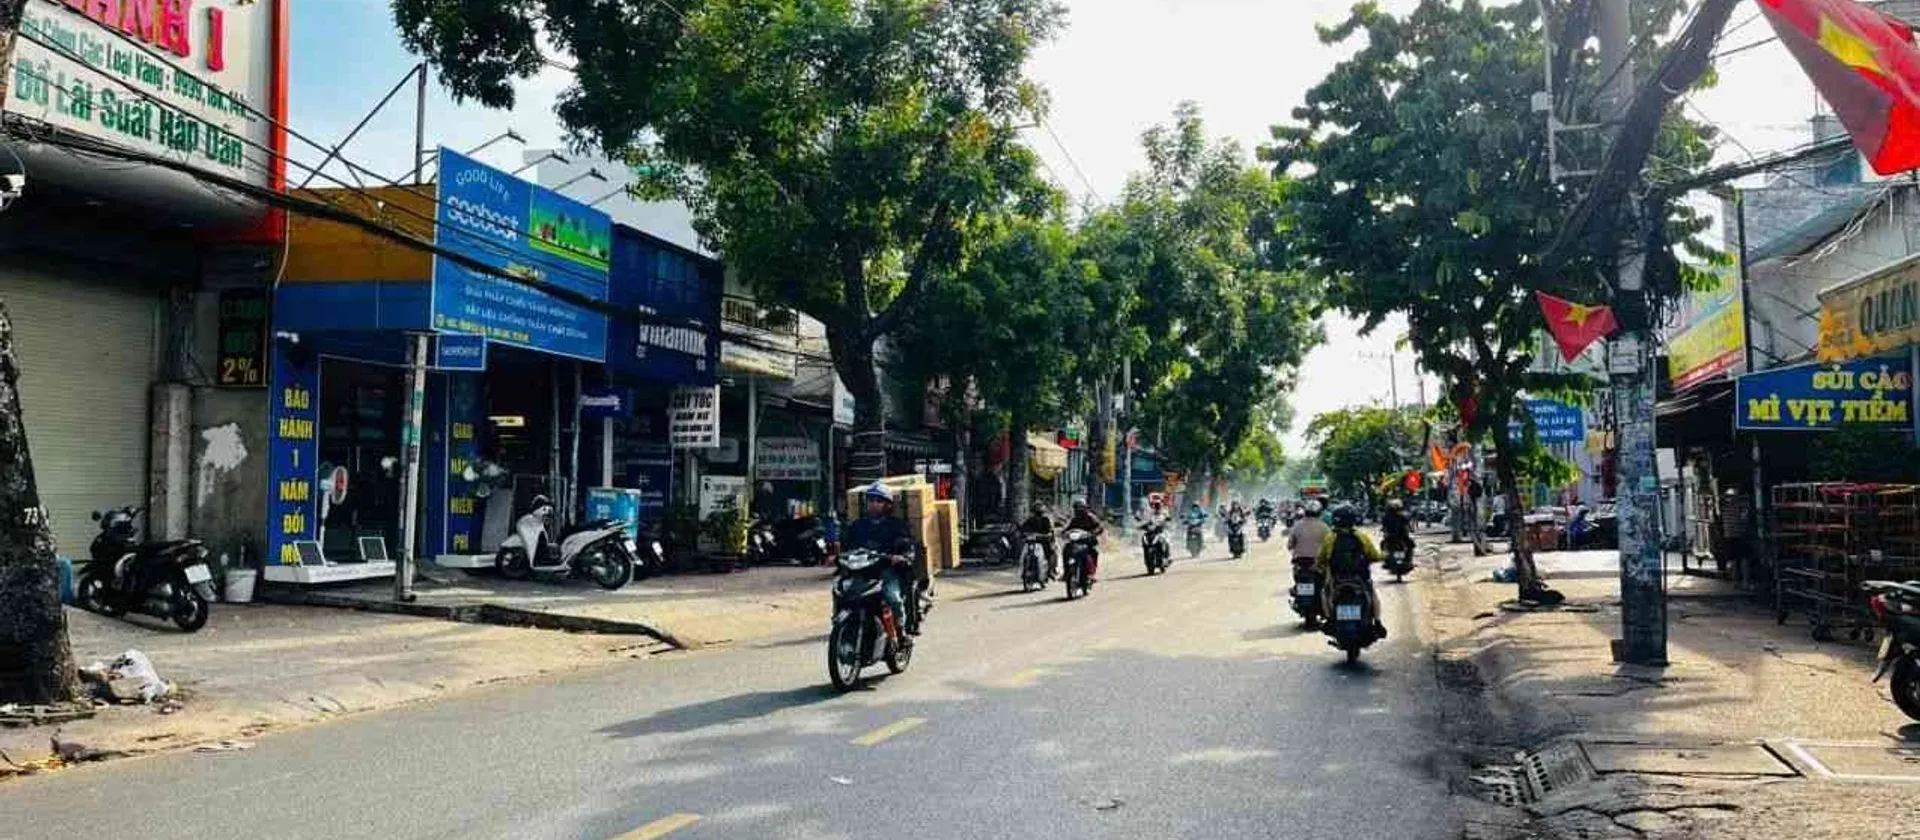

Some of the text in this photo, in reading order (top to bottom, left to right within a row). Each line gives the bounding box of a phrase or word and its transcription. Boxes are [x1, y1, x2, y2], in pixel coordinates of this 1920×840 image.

[207, 7, 223, 71] 1
[55, 71, 93, 121] Lãi
[455, 168, 487, 187] GOOD
[221, 357, 258, 384] 2%
[1747, 392, 1781, 422] MÌ
[1786, 398, 1835, 427] VỊT
[279, 415, 314, 440] HÀNH
